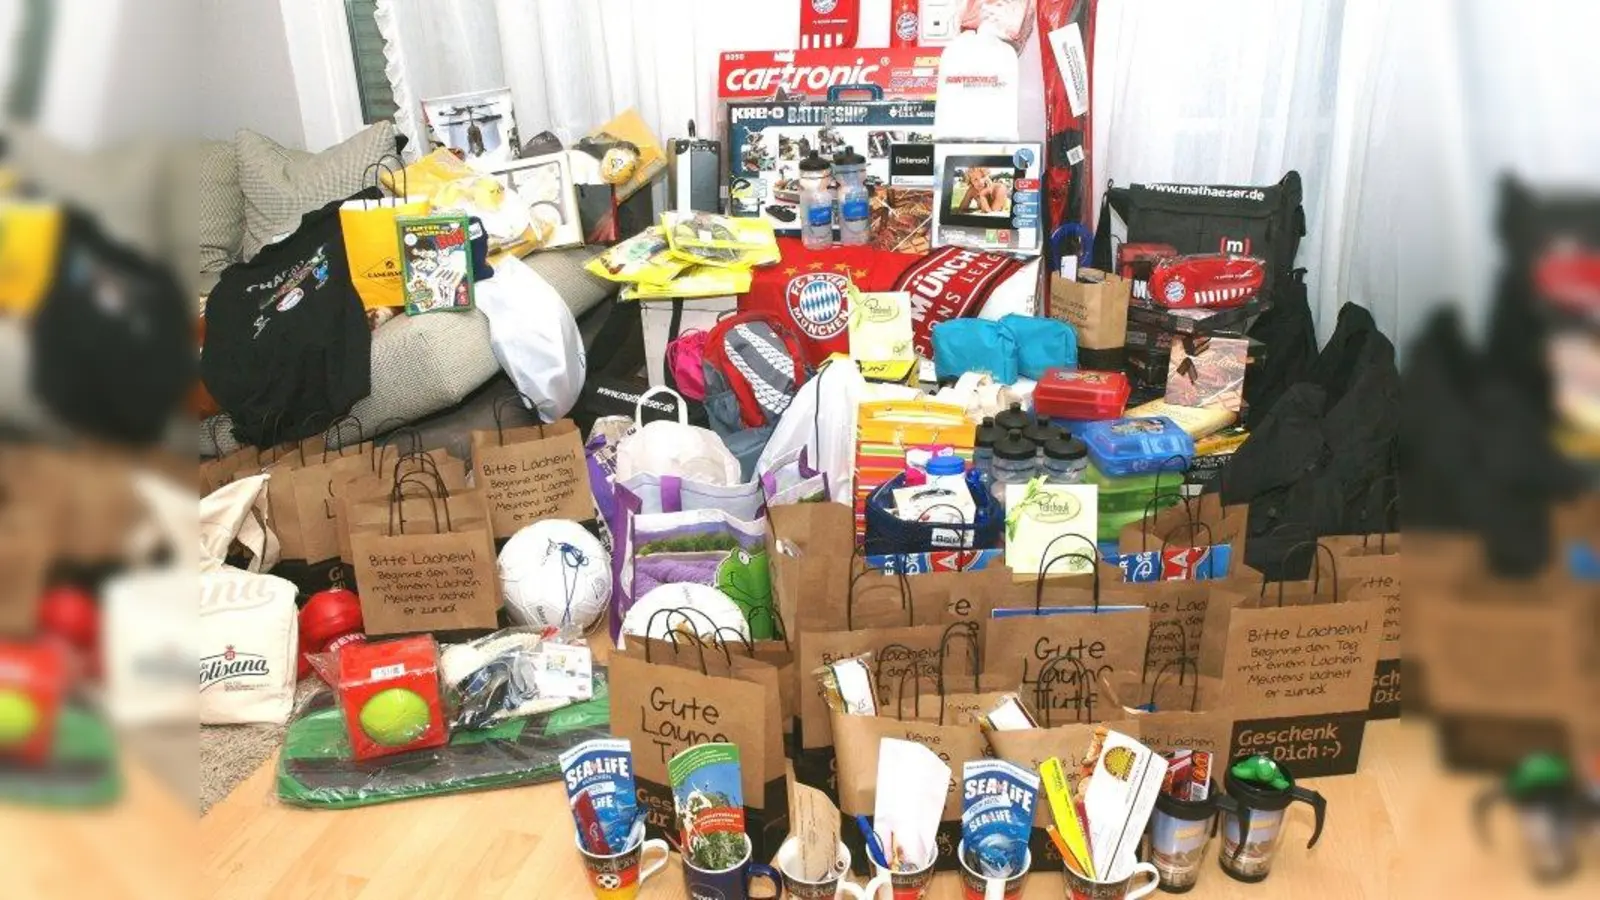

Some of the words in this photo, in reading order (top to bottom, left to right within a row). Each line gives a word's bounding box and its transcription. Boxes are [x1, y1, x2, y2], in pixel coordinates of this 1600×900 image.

[725, 57, 880, 91] cartronic
[1144, 183, 1265, 201] www.mathaeser.de
[791, 278, 806, 296] FC
[483, 463, 517, 476] Bitte
[535, 473, 553, 481] den
[558, 467, 574, 478] Tag
[369, 555, 407, 567] Bitte
[426, 569, 448, 577] den
[453, 566, 474, 578] Tag
[1248, 629, 1290, 643] Bitte
[1034, 636, 1106, 660] Gute
[1305, 643, 1330, 653] den
[1336, 640, 1359, 654] Tag
[650, 686, 720, 725] Gute
[1238, 723, 1339, 746] Geschenk
[1273, 744, 1318, 761] Dich
[565, 759, 593, 791] SEA
[964, 778, 997, 800] SEA
[648, 808, 669, 828] ür
[969, 813, 990, 832] SEA
